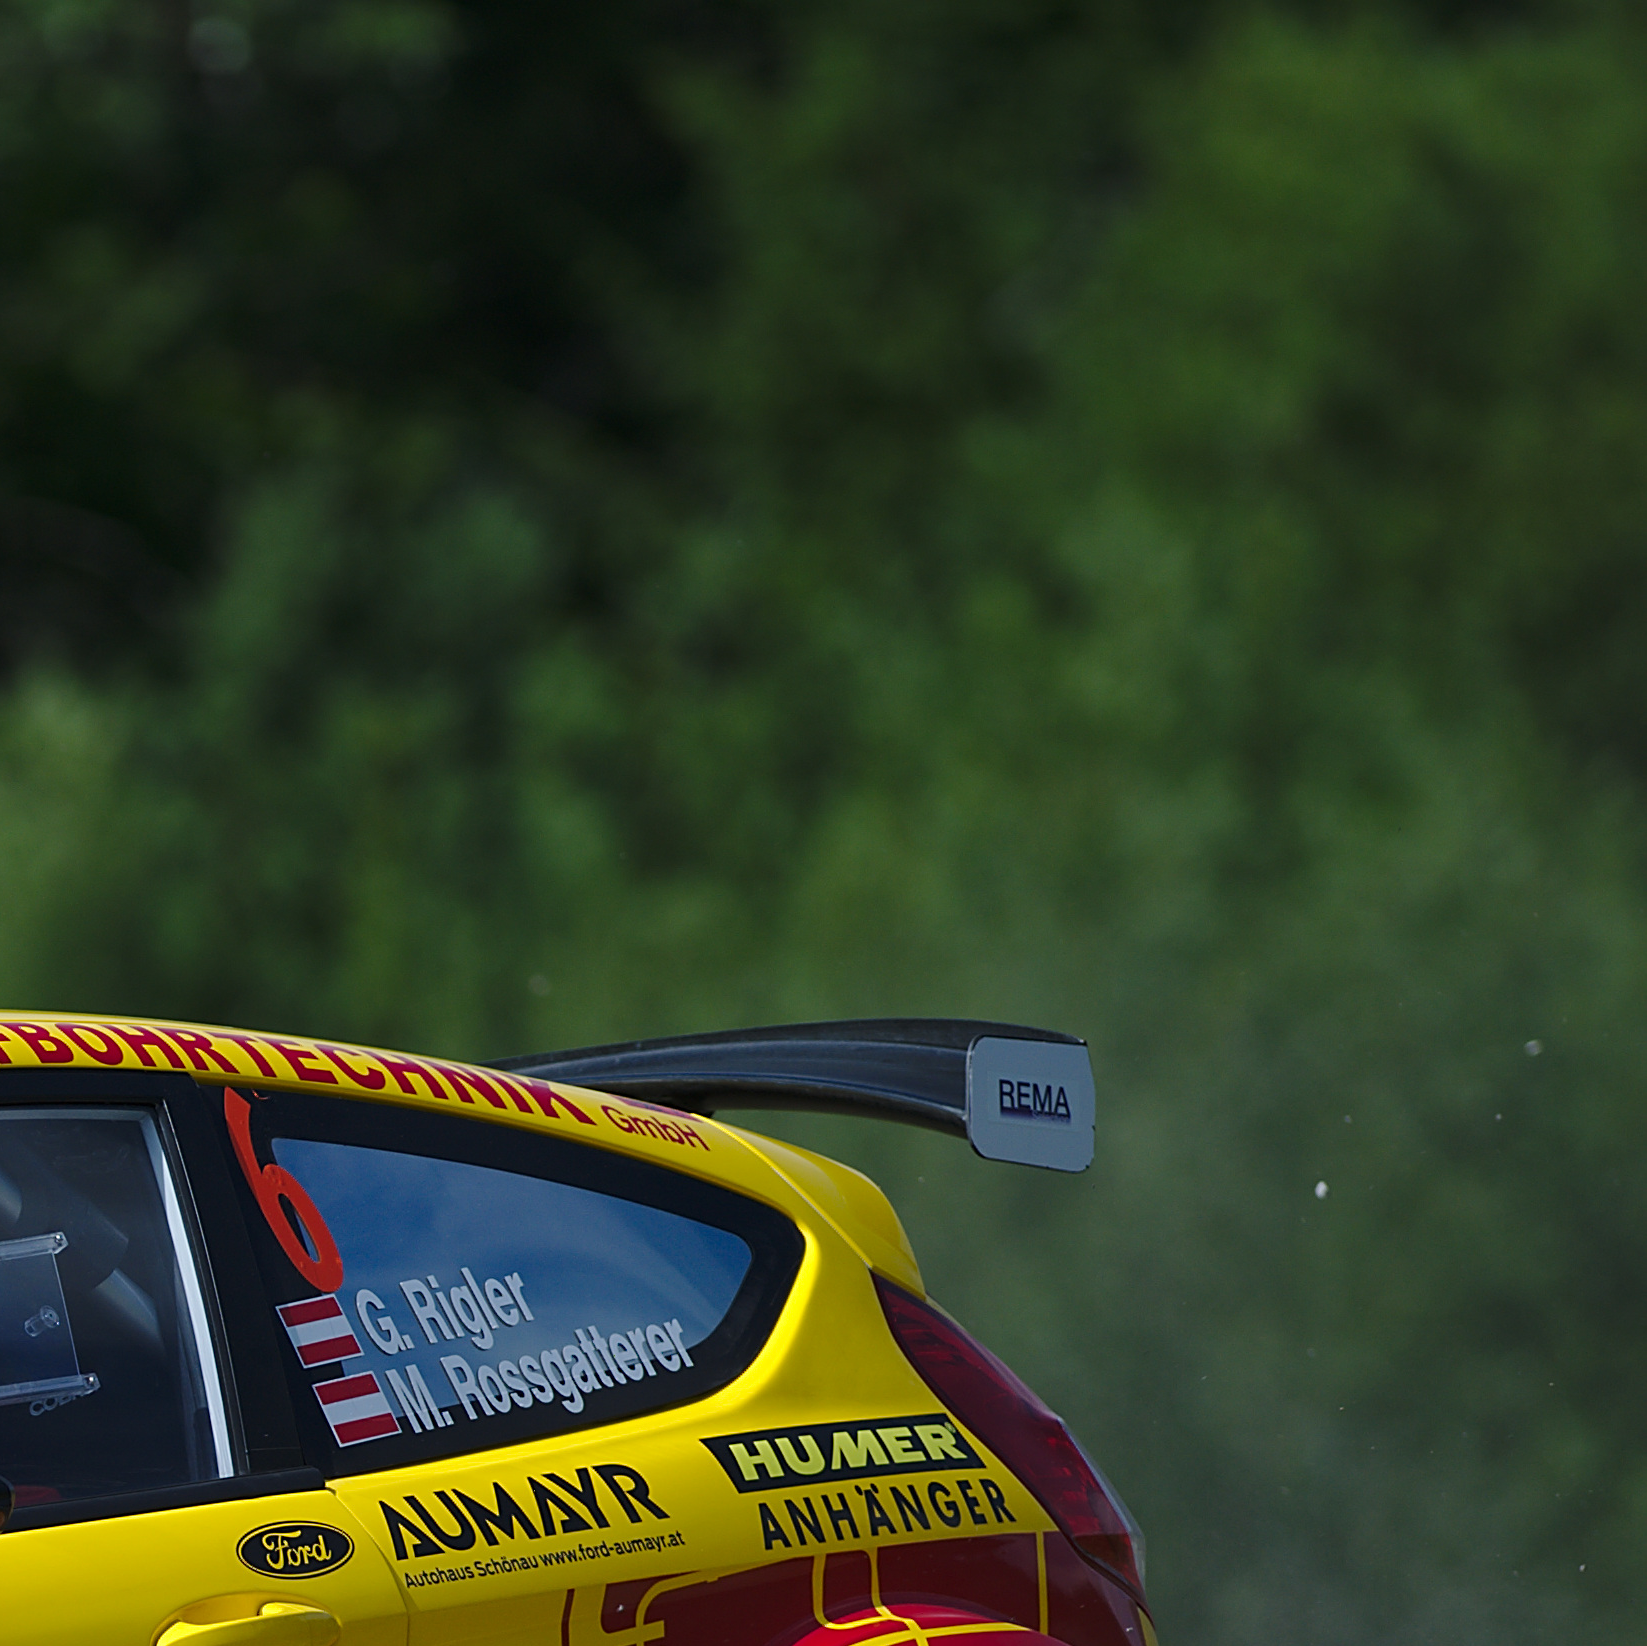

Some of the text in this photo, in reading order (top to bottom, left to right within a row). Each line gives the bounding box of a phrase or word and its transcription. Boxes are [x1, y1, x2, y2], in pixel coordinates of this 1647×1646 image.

[600, 1104, 711, 1151] GmbH
[999, 1079, 1071, 1119] REMA
[224, 1086, 344, 1293] 6
[355, 1267, 535, 1356] G. Rigler
[388, 1317, 696, 1434] M. Rossgatterer
[728, 1423, 969, 1482] HUMER
[378, 1464, 671, 1561] AUMAYR
[757, 1478, 1017, 1551] ANHÄNGER
[262, 1529, 332, 1570] Ford
[405, 1531, 686, 1589] Autohaus Schönau www.ford-aumayr.at
